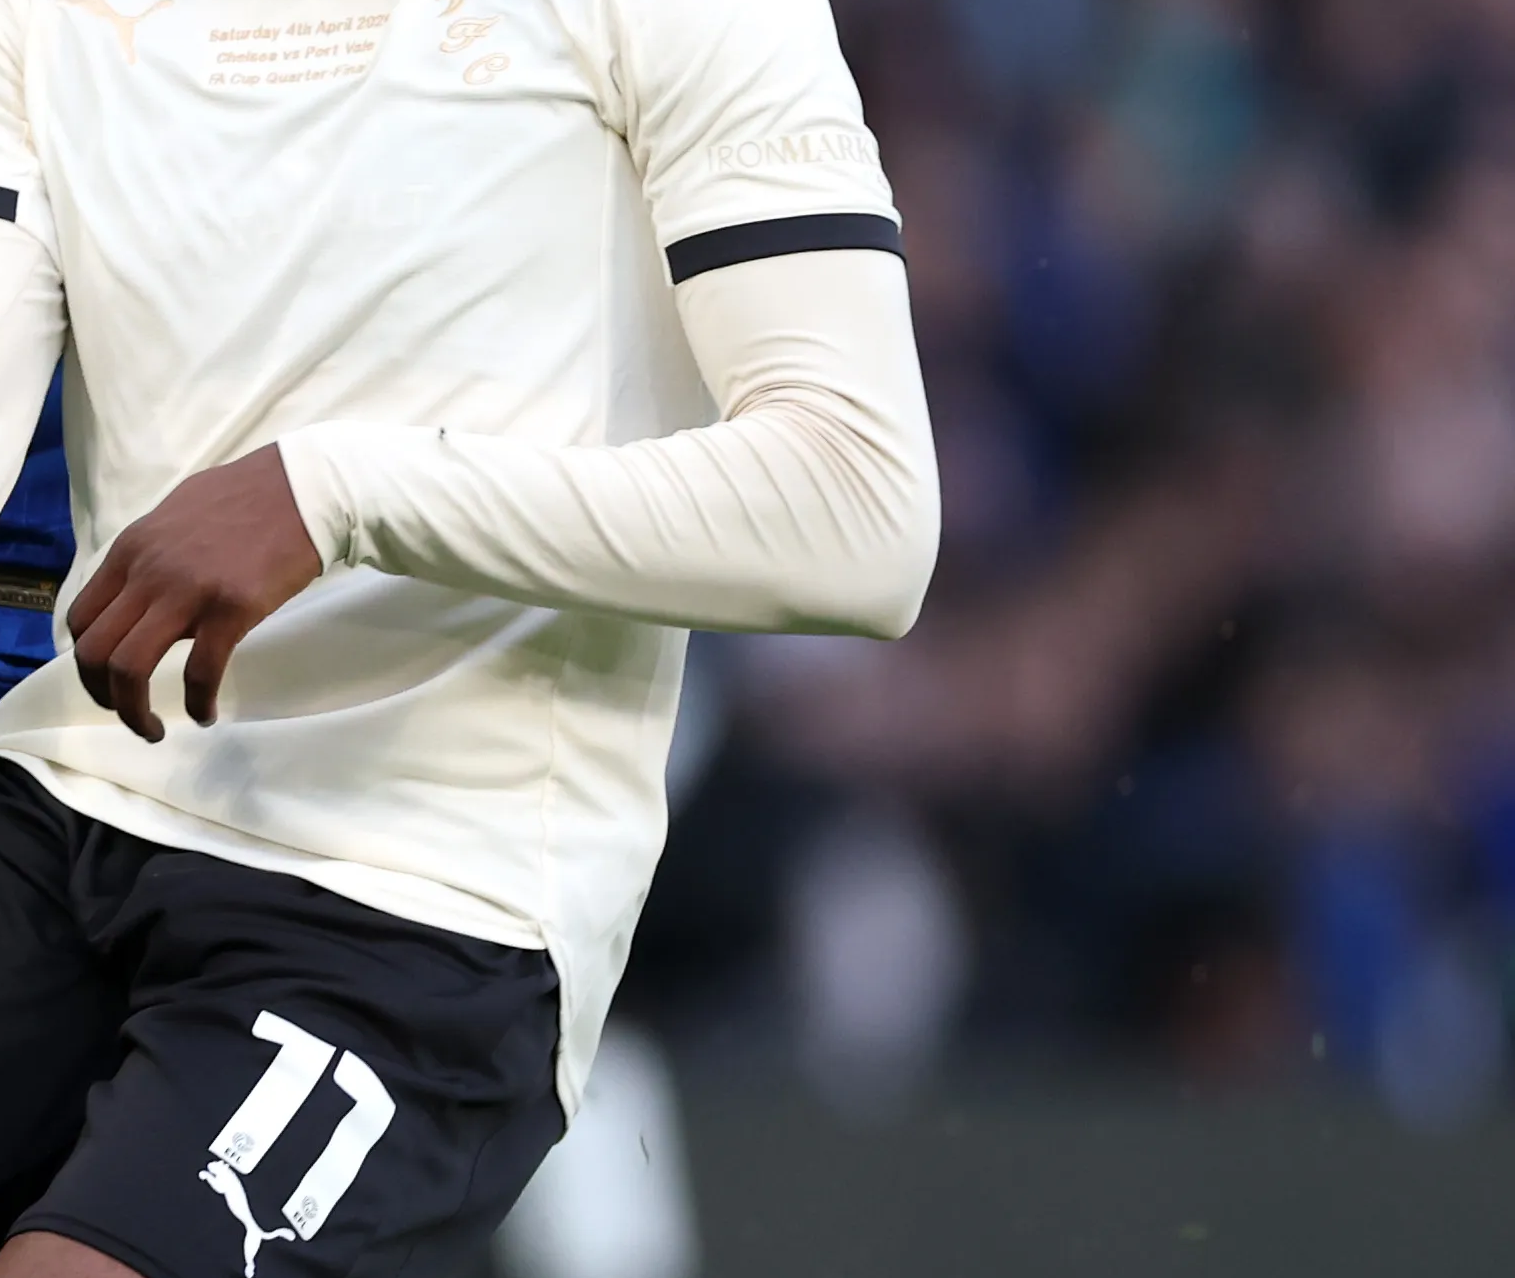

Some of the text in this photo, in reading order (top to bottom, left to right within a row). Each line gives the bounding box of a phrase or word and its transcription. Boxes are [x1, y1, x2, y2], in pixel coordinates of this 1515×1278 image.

[208, 24, 281, 43] Saturday
[316, 16, 353, 36] April
[216, 38, 376, 65] Chelsea vs Port Vale
[208, 72, 226, 86] FA
[229, 71, 261, 87] Cup
[706, 132, 881, 172] IRONMARK
